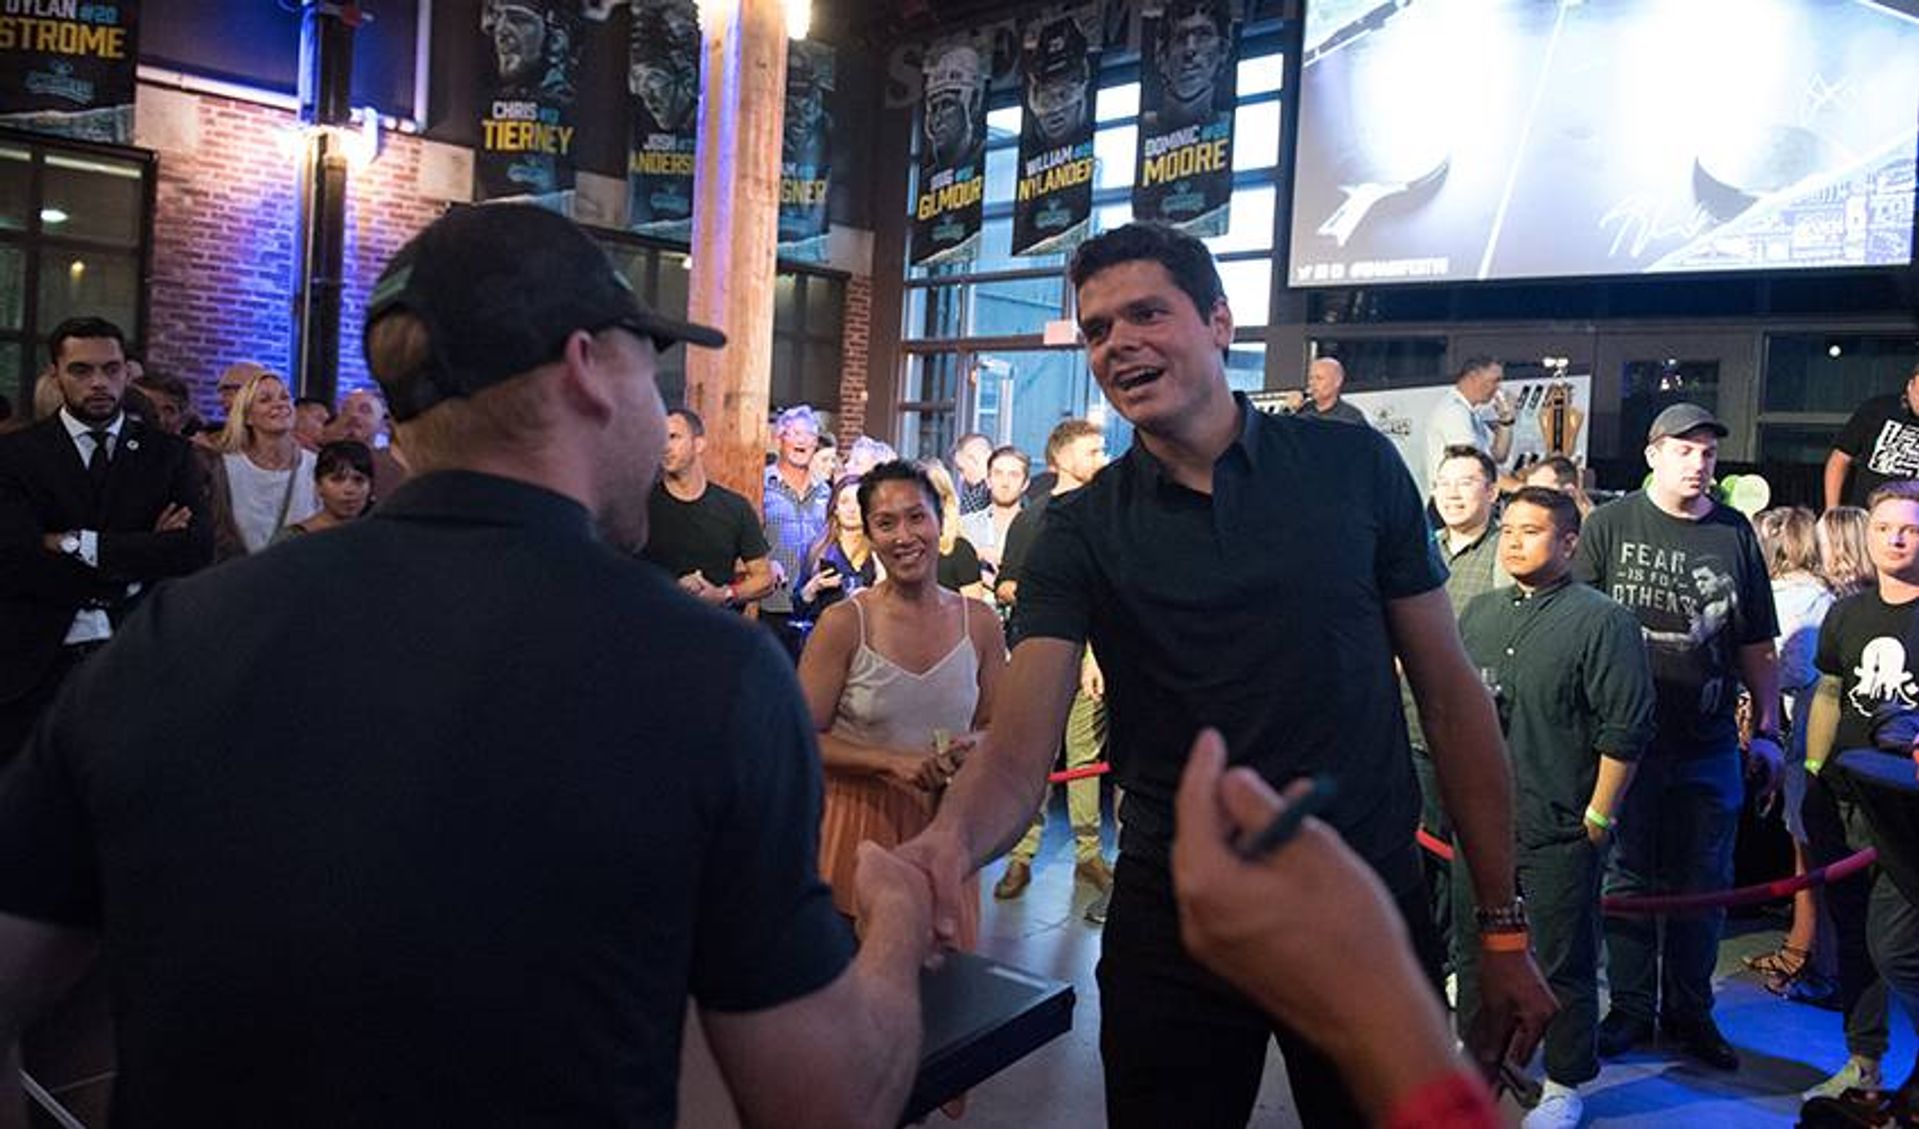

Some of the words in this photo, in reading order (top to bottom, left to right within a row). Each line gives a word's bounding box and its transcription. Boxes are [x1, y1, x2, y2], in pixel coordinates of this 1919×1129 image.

[0, 17, 126, 58] STROME
[482, 120, 575, 155] TIERNEY
[1142, 138, 1229, 188] MOORE
[917, 175, 983, 220] GILMOUR
[1620, 541, 1686, 575] FEAR
